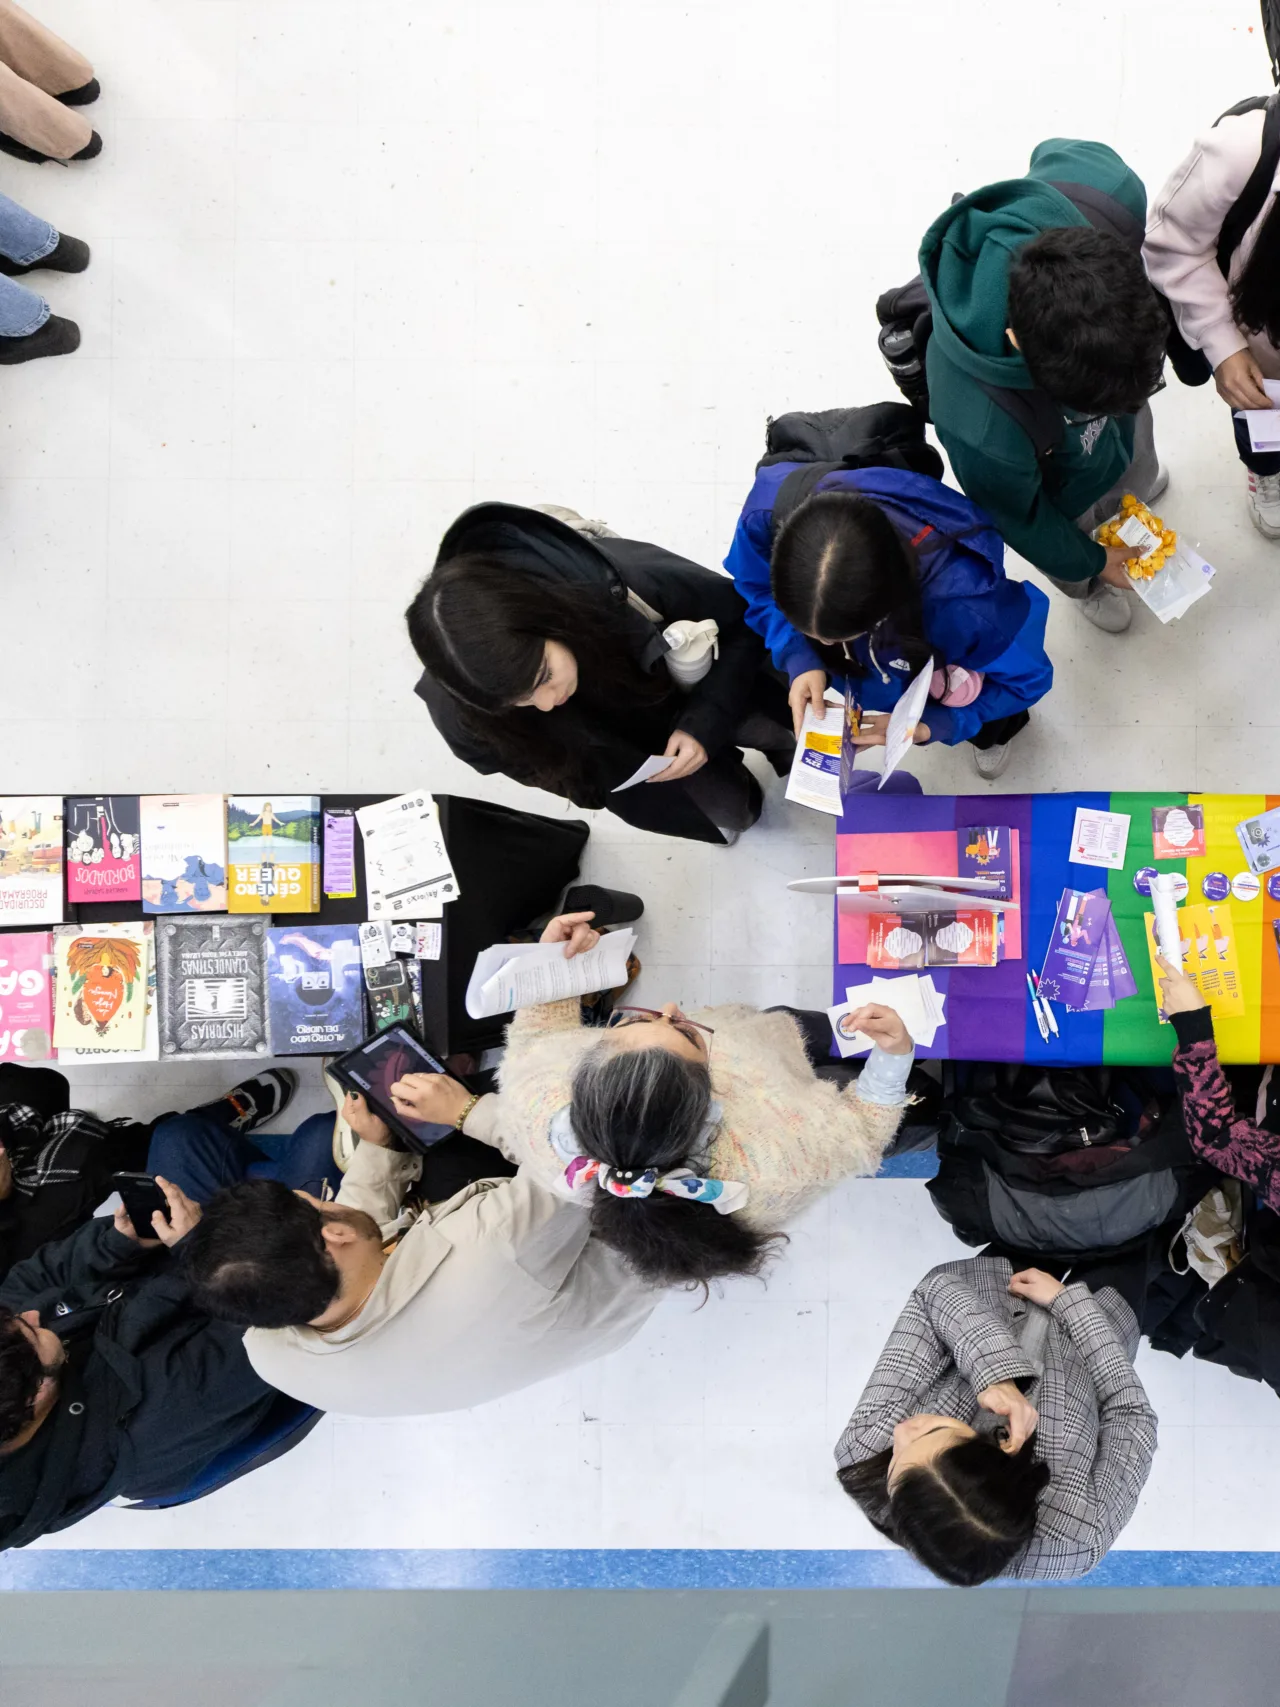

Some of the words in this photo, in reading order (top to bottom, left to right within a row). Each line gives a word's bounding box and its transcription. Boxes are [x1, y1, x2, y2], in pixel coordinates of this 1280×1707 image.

[75, 863, 136, 887] BORDADOS
[235, 867, 301, 881] QUEER
[234, 882, 301, 898] GÉNERO
[181, 958, 249, 976] CLANDESTINAS
[190, 1023, 244, 1040] HISTORIAS
[323, 1024, 339, 1034] DEL
